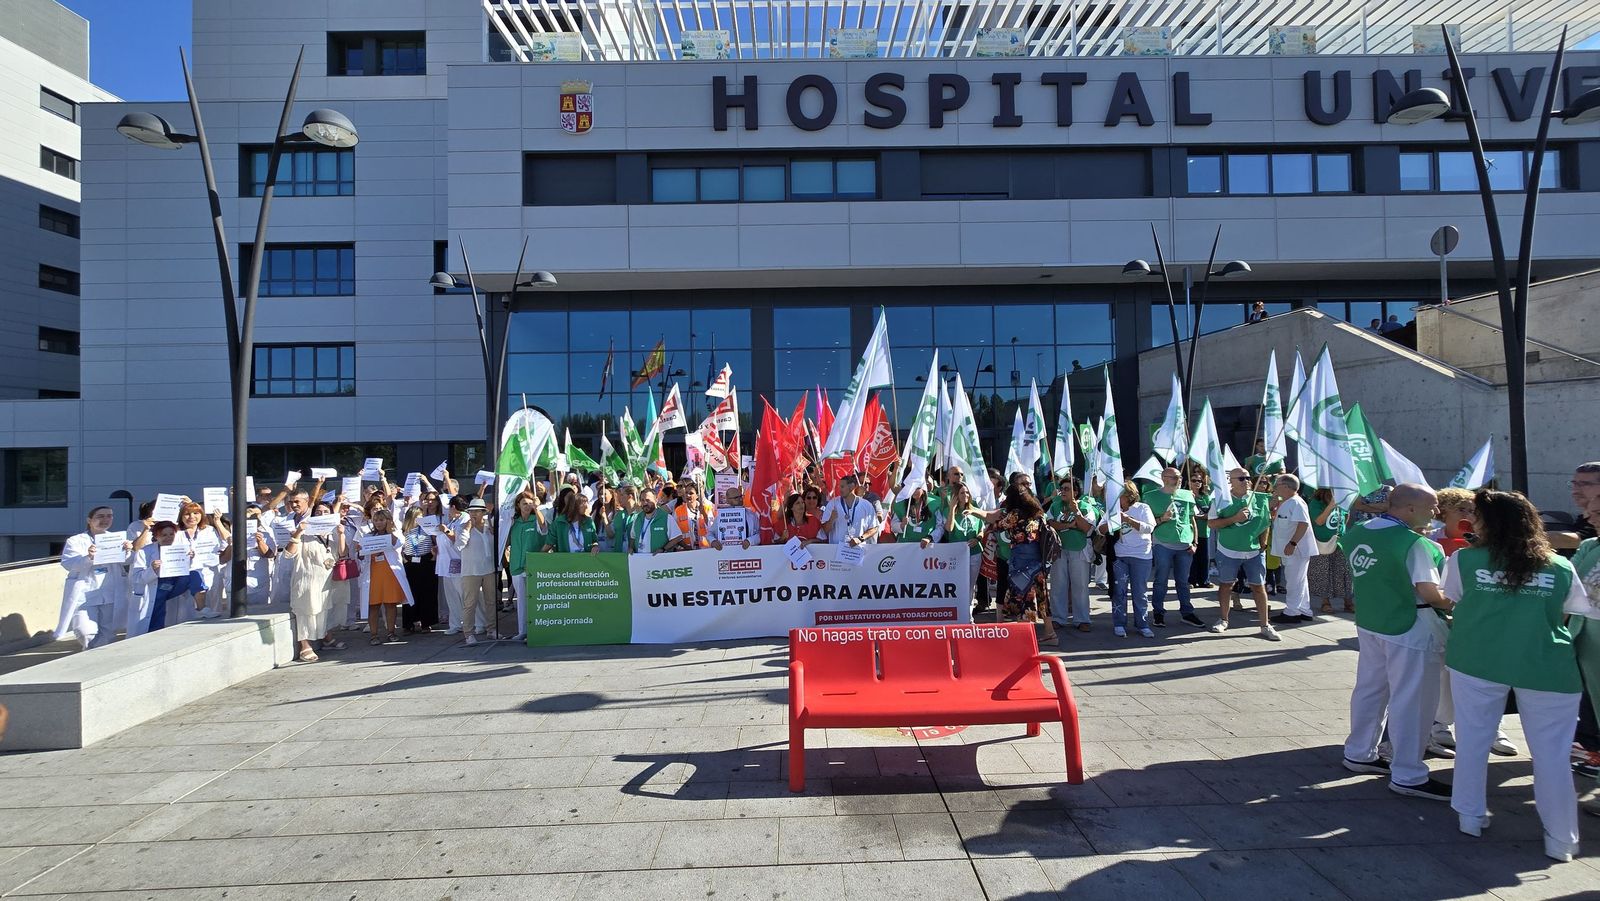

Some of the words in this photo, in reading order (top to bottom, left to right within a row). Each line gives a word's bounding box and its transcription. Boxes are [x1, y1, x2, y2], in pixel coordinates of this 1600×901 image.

[712, 71, 1213, 131] HOSPITAL
[731, 561, 760, 569] CCOO
[562, 570, 609, 578] clasificación
[651, 567, 693, 579] SATSE
[537, 580, 580, 588] profesional
[537, 592, 577, 600] Jubilación
[579, 592, 618, 600] anticipada
[647, 593, 677, 607] UN
[683, 586, 792, 607] ESTATUTO
[797, 585, 853, 601] PARA
[857, 583, 957, 600] AVANZAR
[537, 603, 542, 611] y
[543, 602, 570, 610] parcial
[535, 618, 562, 626] Mejora
[563, 617, 593, 625] jornada
[798, 629, 817, 642] No
[822, 629, 863, 644] hagas
[867, 627, 901, 641] trato
[906, 629, 930, 640] con
[935, 626, 947, 639] el
[952, 626, 1009, 639] maltrato
